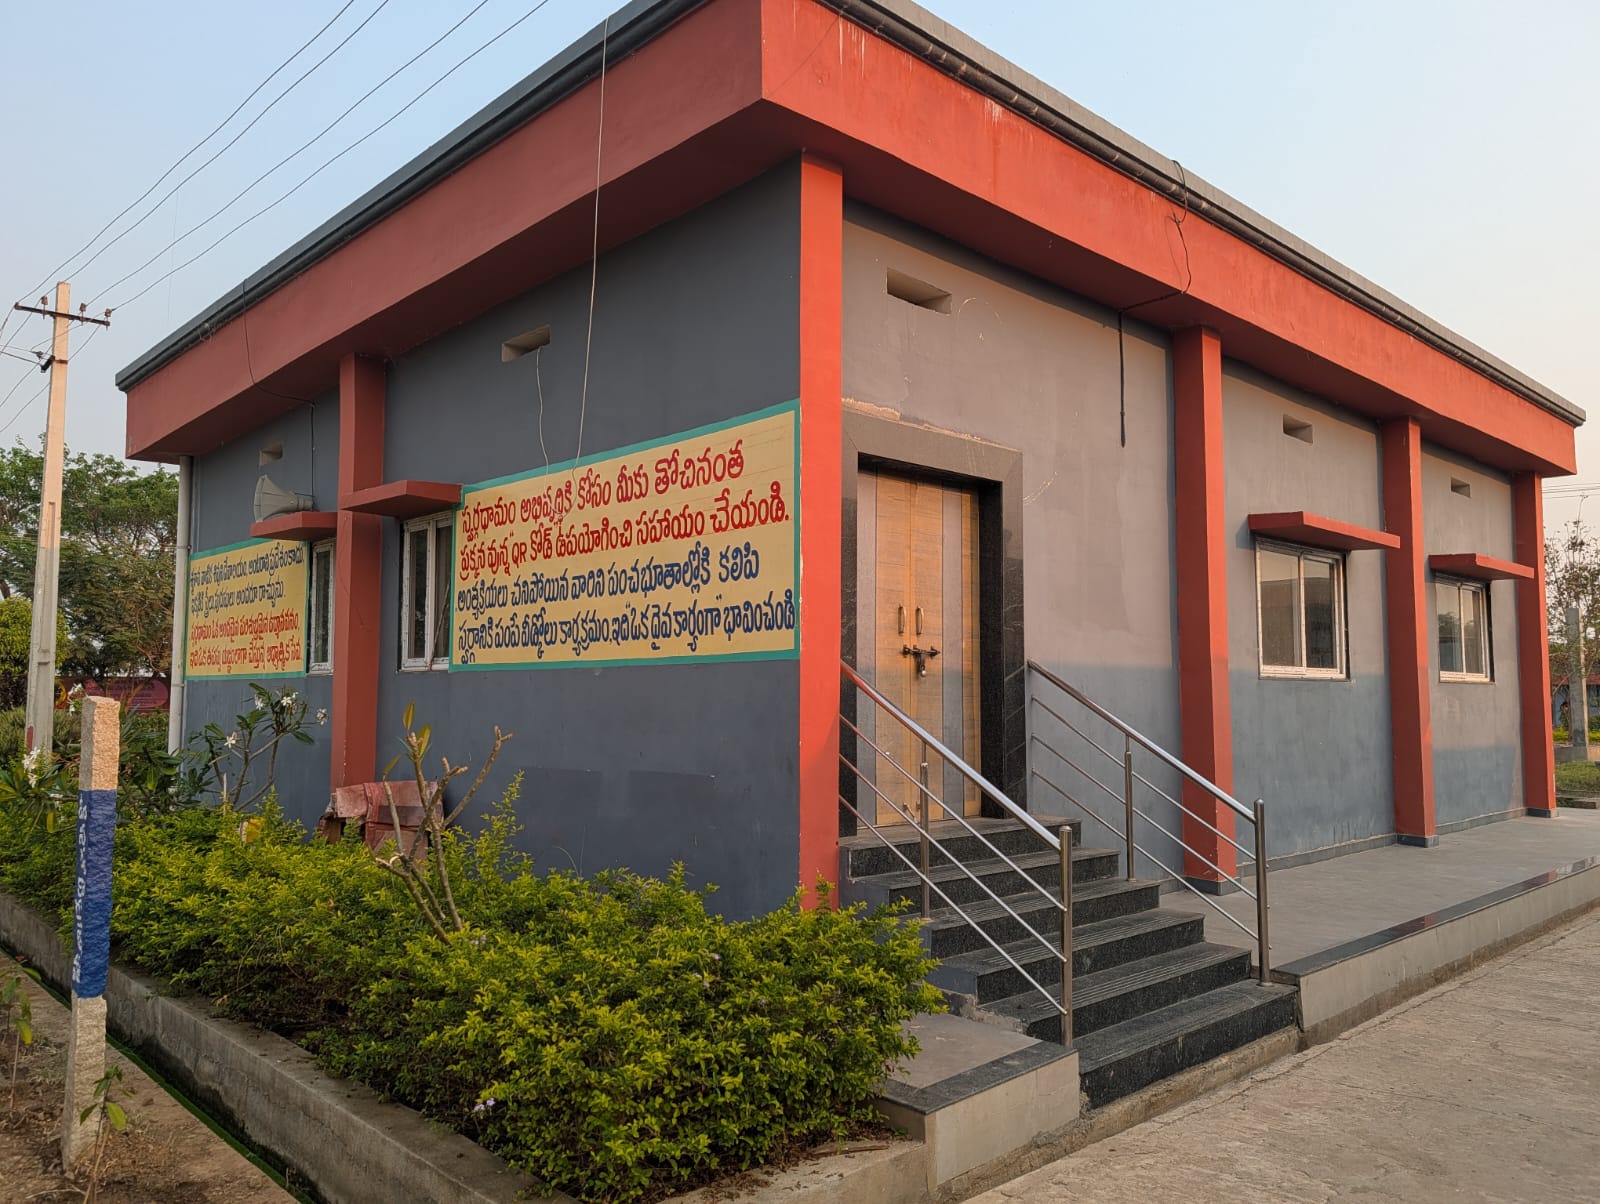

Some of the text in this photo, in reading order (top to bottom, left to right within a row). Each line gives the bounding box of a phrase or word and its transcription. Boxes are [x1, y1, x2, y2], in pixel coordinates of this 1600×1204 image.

[577, 468, 611, 510] కోసం
[616, 464, 648, 503] మీకు
[655, 439, 744, 495] తోచినంత
[460, 541, 486, 581] ప్రక్కన
[556, 517, 632, 557] ఉపయోగించి
[636, 504, 705, 545] సహాయం
[710, 481, 789, 533] చేయండి.
[511, 568, 569, 606] చనిపోయిన
[571, 568, 605, 598] వారిని
[719, 541, 759, 583] కలిపి
